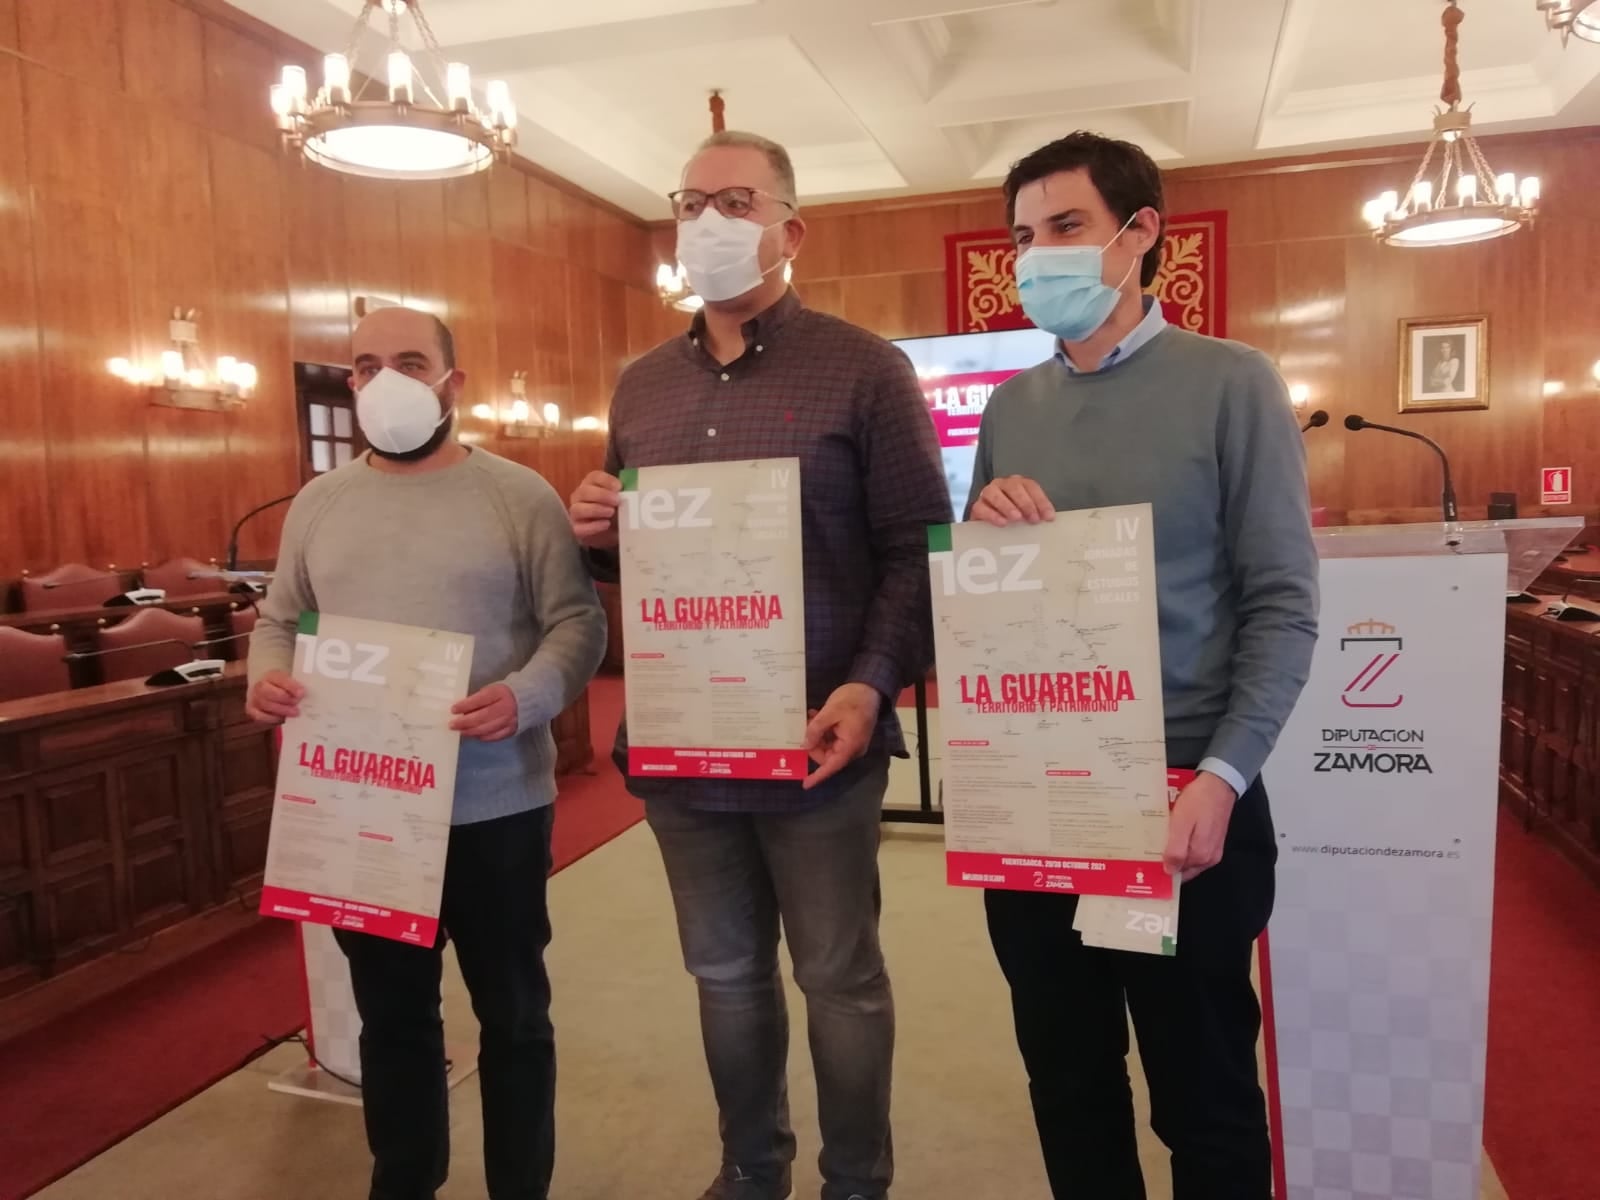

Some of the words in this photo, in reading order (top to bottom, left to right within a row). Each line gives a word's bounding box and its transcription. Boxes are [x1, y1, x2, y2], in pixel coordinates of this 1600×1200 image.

[771, 468, 790, 489] IV
[1115, 517, 1140, 541] IV
[641, 598, 667, 623] LA
[674, 590, 783, 623] GUAREÑA
[960, 674, 992, 704] LA
[1001, 665, 1135, 704] GUAREÑA
[977, 701, 1036, 714] TERRITORIO
[1039, 701, 1047, 713] Y
[1050, 700, 1119, 713] PATRIMONIO
[299, 742, 325, 770] LA
[334, 748, 436, 789] GUAREÑA
[1313, 752, 1433, 774] ZAMORA
